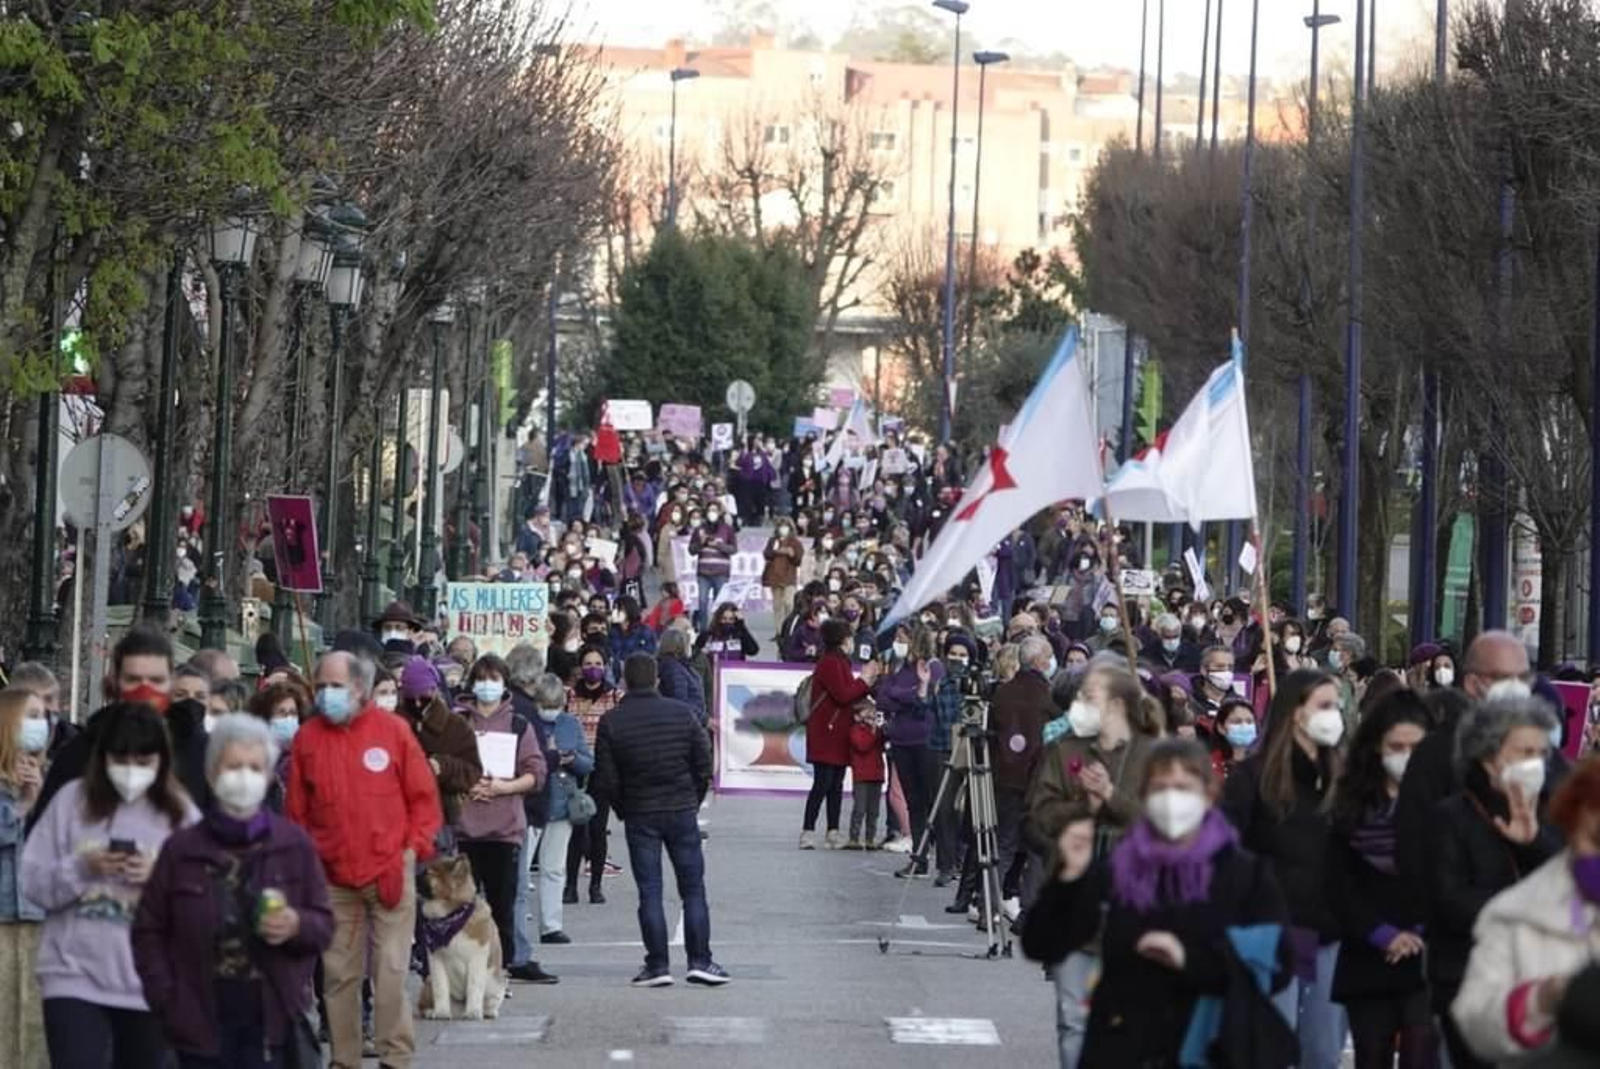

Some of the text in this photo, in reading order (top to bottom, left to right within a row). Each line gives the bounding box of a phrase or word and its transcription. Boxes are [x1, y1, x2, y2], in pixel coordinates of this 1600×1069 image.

[451, 588, 545, 611] AS MULLERES
[458, 611, 538, 637] TRANS
